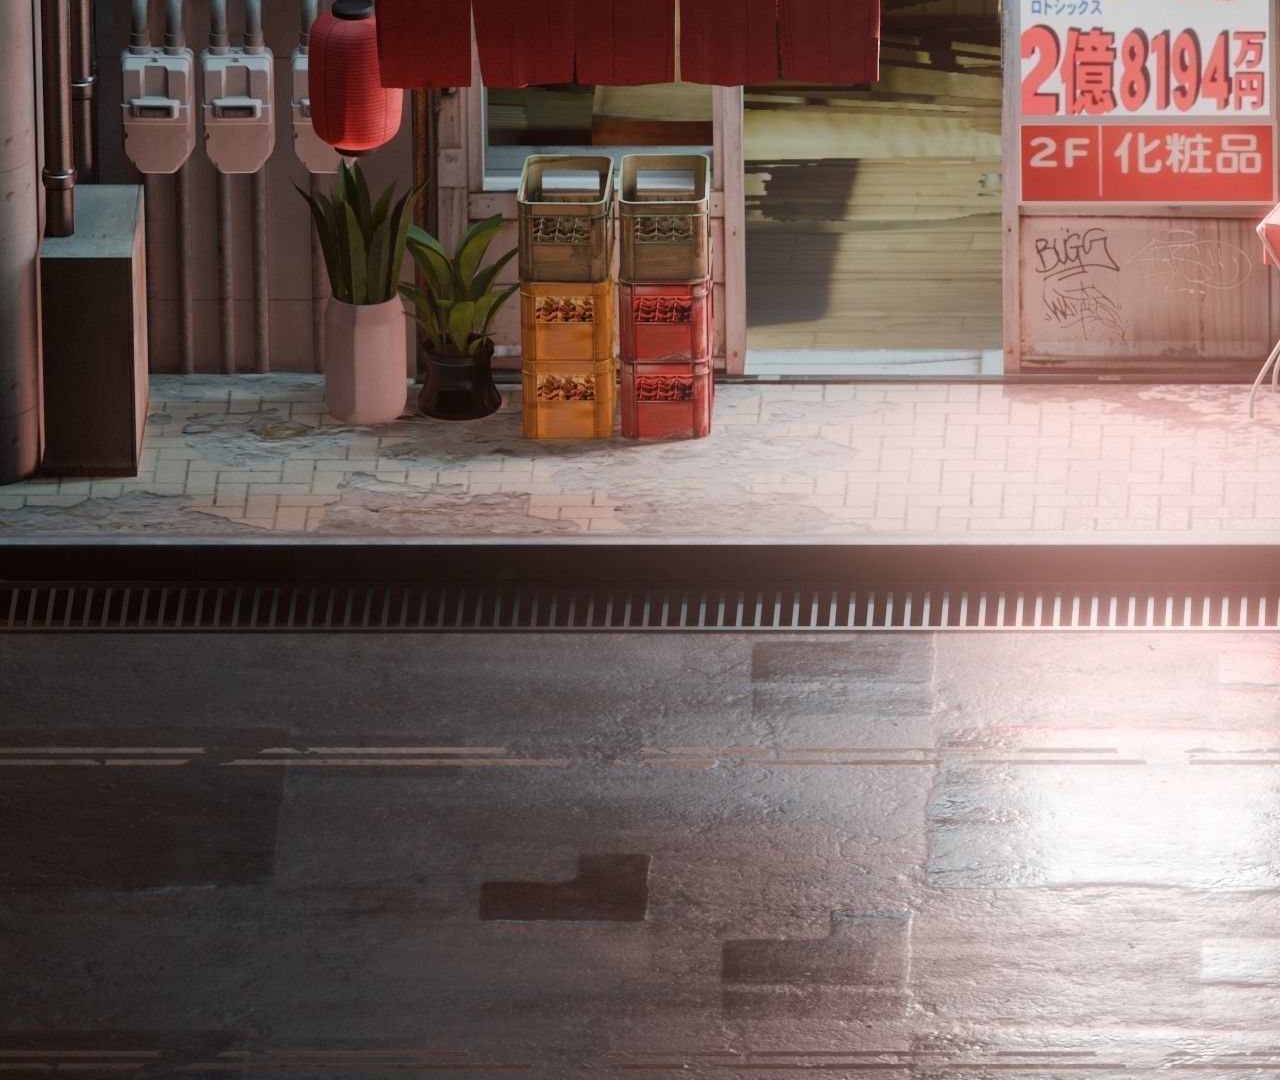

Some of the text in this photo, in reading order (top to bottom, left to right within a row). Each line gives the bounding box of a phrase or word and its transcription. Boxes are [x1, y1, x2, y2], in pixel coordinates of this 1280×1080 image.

[1031, 0, 1103, 15] ロトシックス
[1029, 132, 1262, 174] 2F 化粧品
